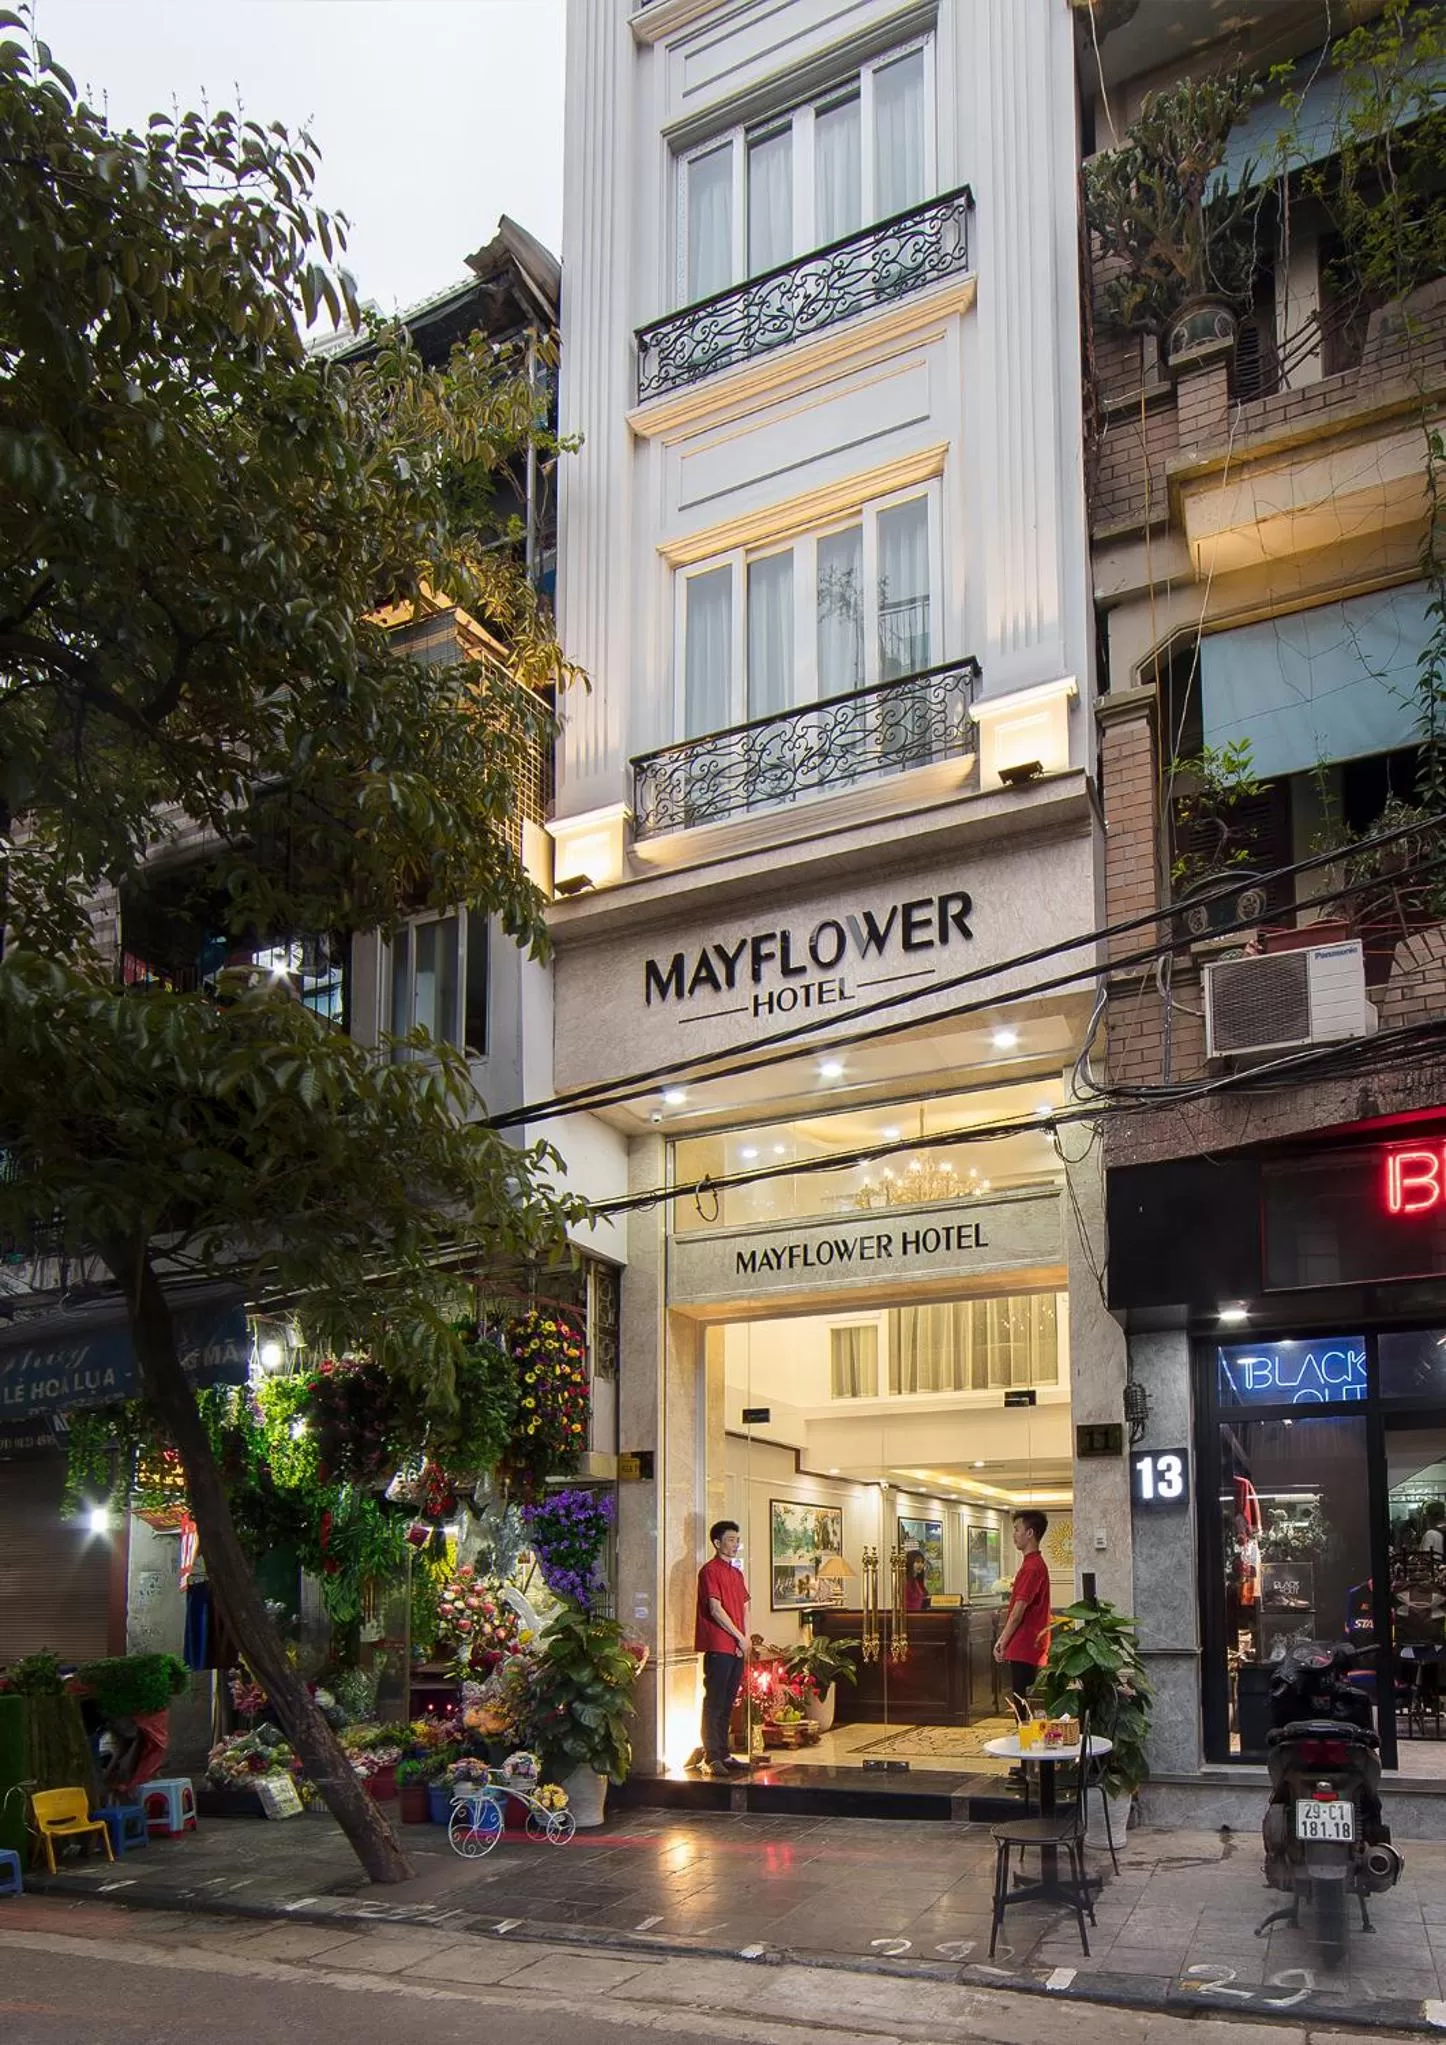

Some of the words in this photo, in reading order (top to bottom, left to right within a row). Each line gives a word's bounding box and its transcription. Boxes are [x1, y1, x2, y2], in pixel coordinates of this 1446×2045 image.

[645, 890, 974, 1006] MAYFLOWER
[752, 977, 856, 1017] HOTEL
[1387, 1145, 1446, 1213] B
[736, 1233, 893, 1275] MAYFLOWER
[901, 1222, 989, 1256] HOTEL
[1245, 1350, 1367, 1390] BLACK
[1084, 1430, 1113, 1451] 11
[1136, 1454, 1184, 1499] 13
[1302, 1820, 1351, 1839] 181.18
